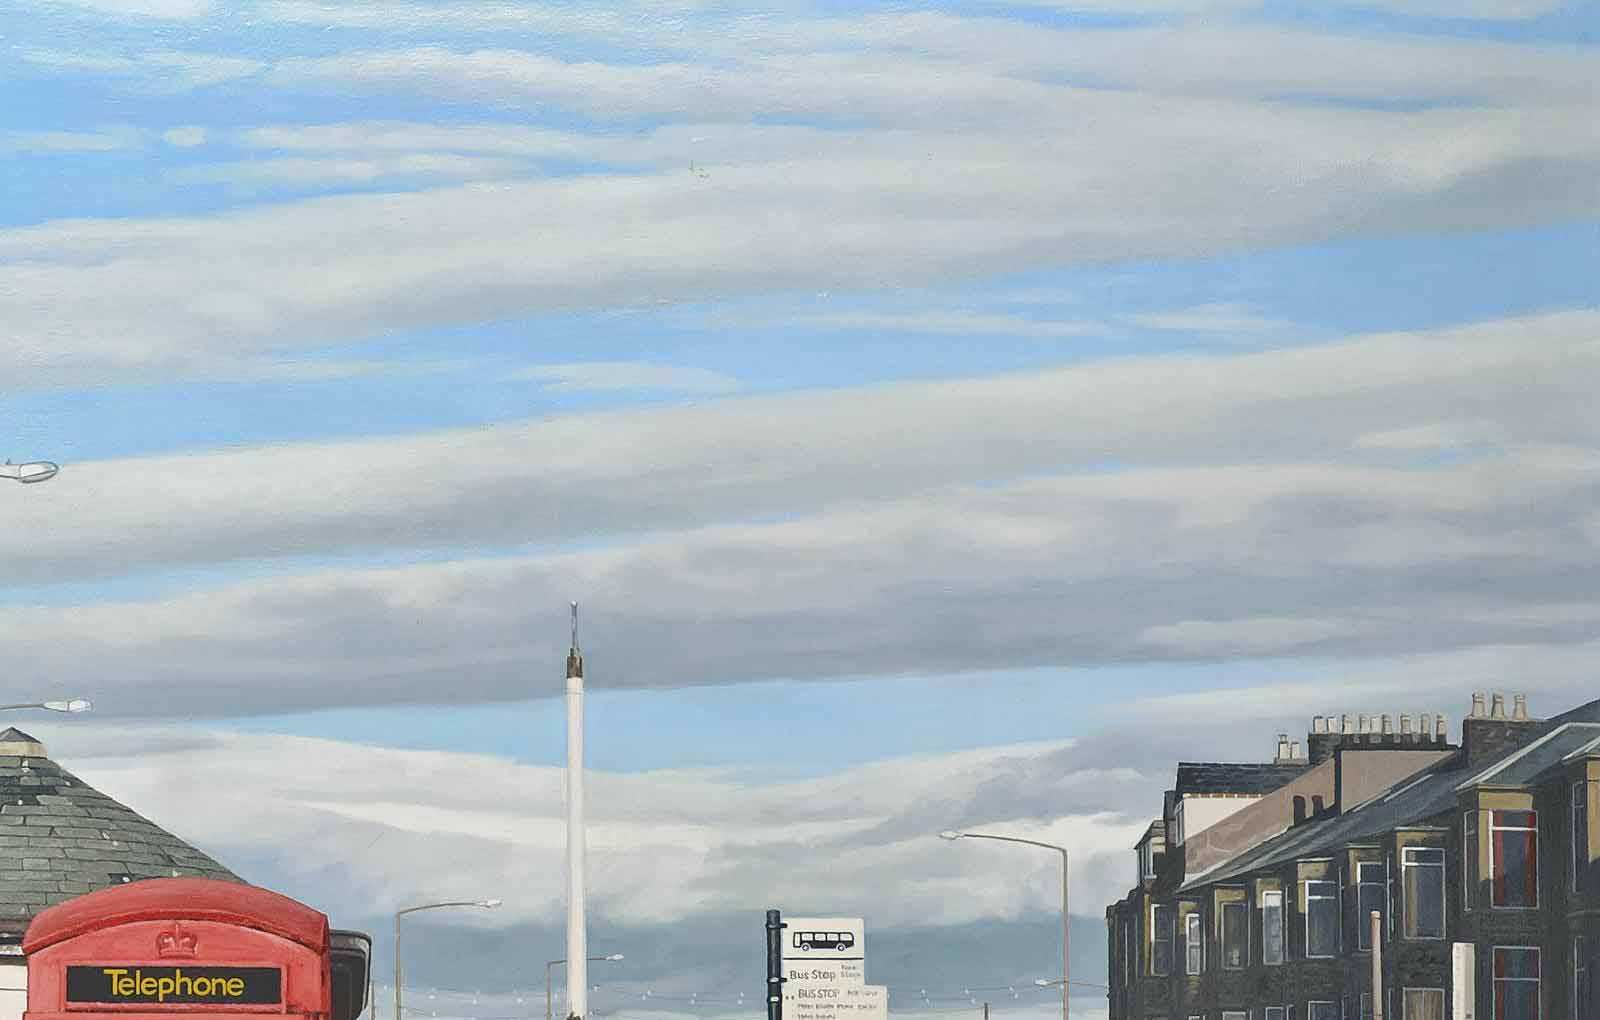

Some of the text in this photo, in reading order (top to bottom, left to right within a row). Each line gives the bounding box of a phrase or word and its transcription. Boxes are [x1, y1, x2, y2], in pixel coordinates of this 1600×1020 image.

[103, 968, 245, 1002] Telephone
[790, 969, 809, 980] Bus
[811, 968, 836, 982] Stop
